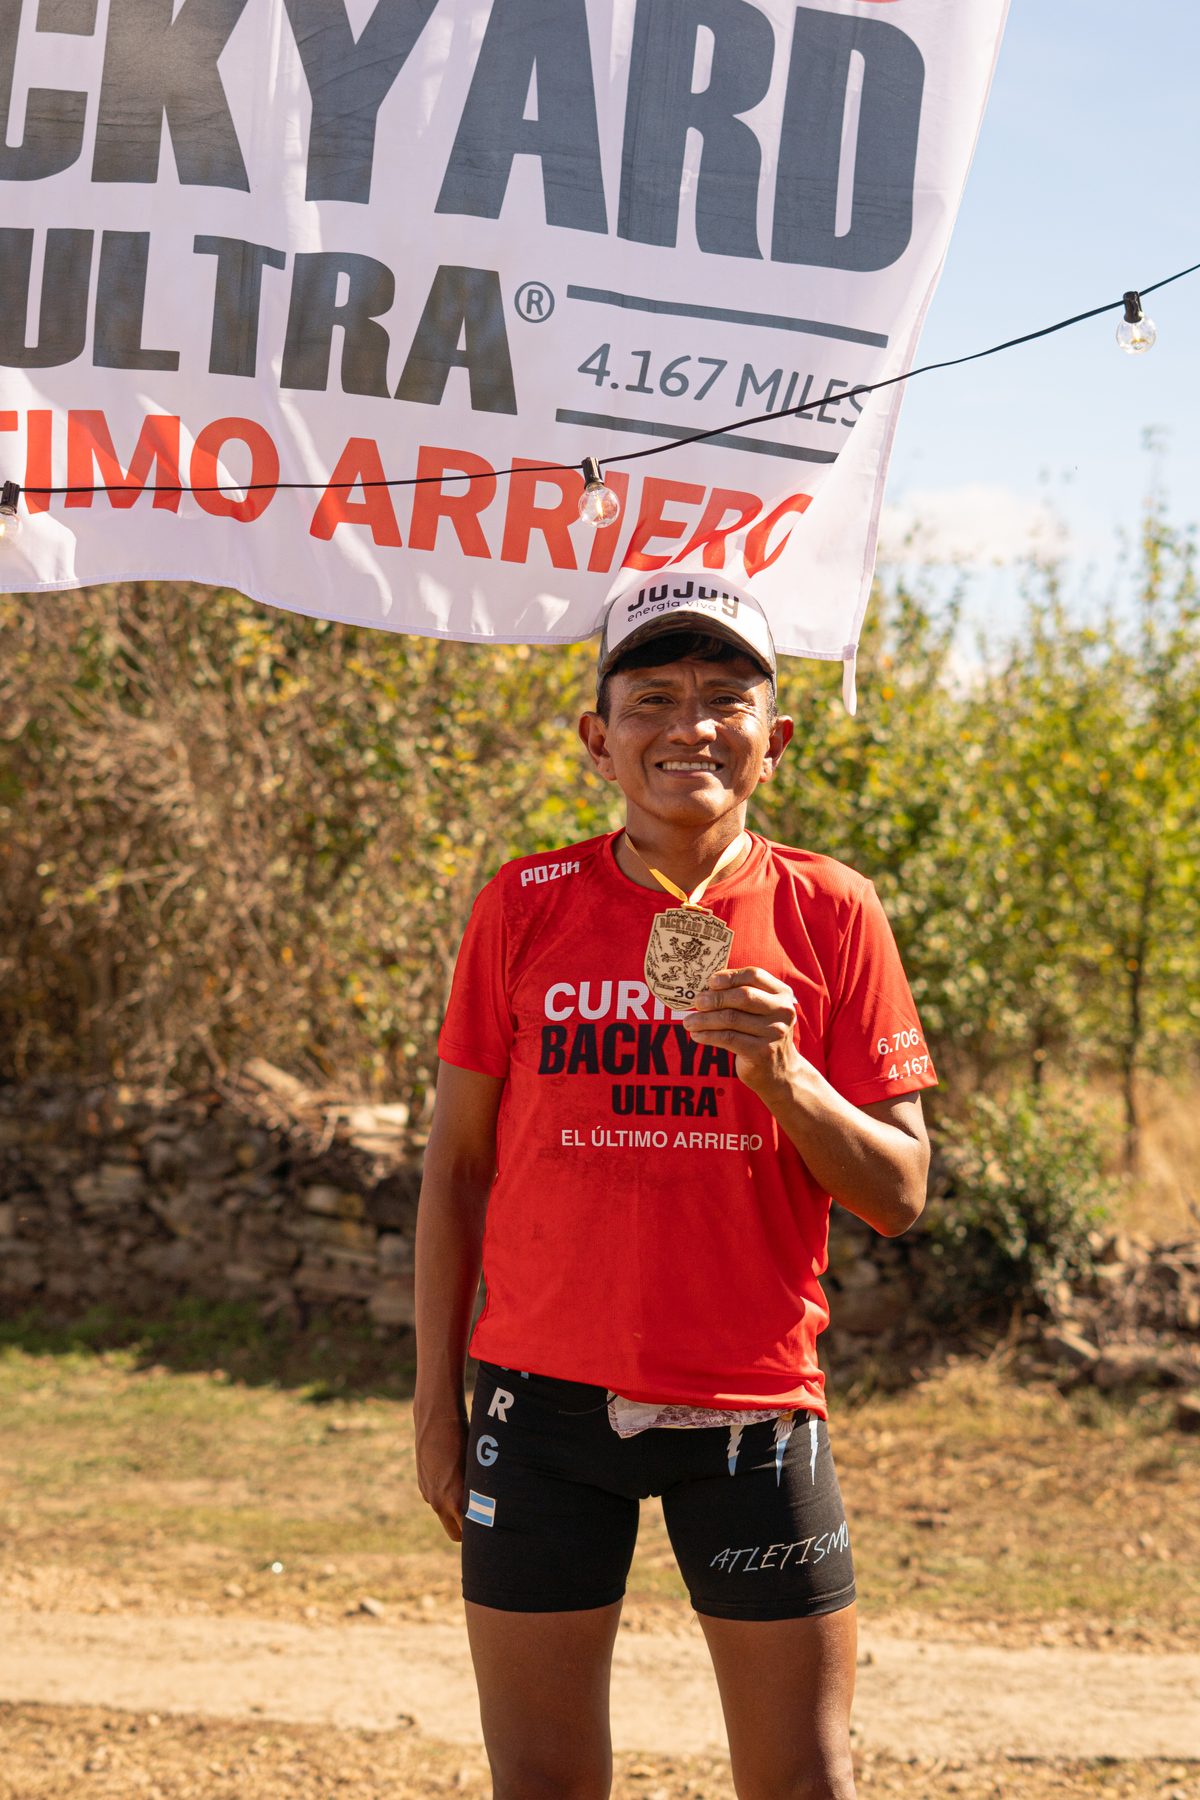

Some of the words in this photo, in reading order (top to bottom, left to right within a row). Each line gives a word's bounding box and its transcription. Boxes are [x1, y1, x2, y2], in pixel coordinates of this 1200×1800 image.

[577, 343, 727, 400] 4.167
[735, 363, 872, 427] MILES
[0, 410, 280, 522] IMO
[537, 1023, 738, 1078] BACKYA
[877, 1028, 919, 1055] 6.706
[888, 1055, 929, 1080] 4.167
[561, 1129, 586, 1146] EL
[592, 1126, 668, 1148] ÚLTIMO
[673, 1132, 763, 1151] ARRIERO
[709, 1520, 848, 1573] ATLETISMO
